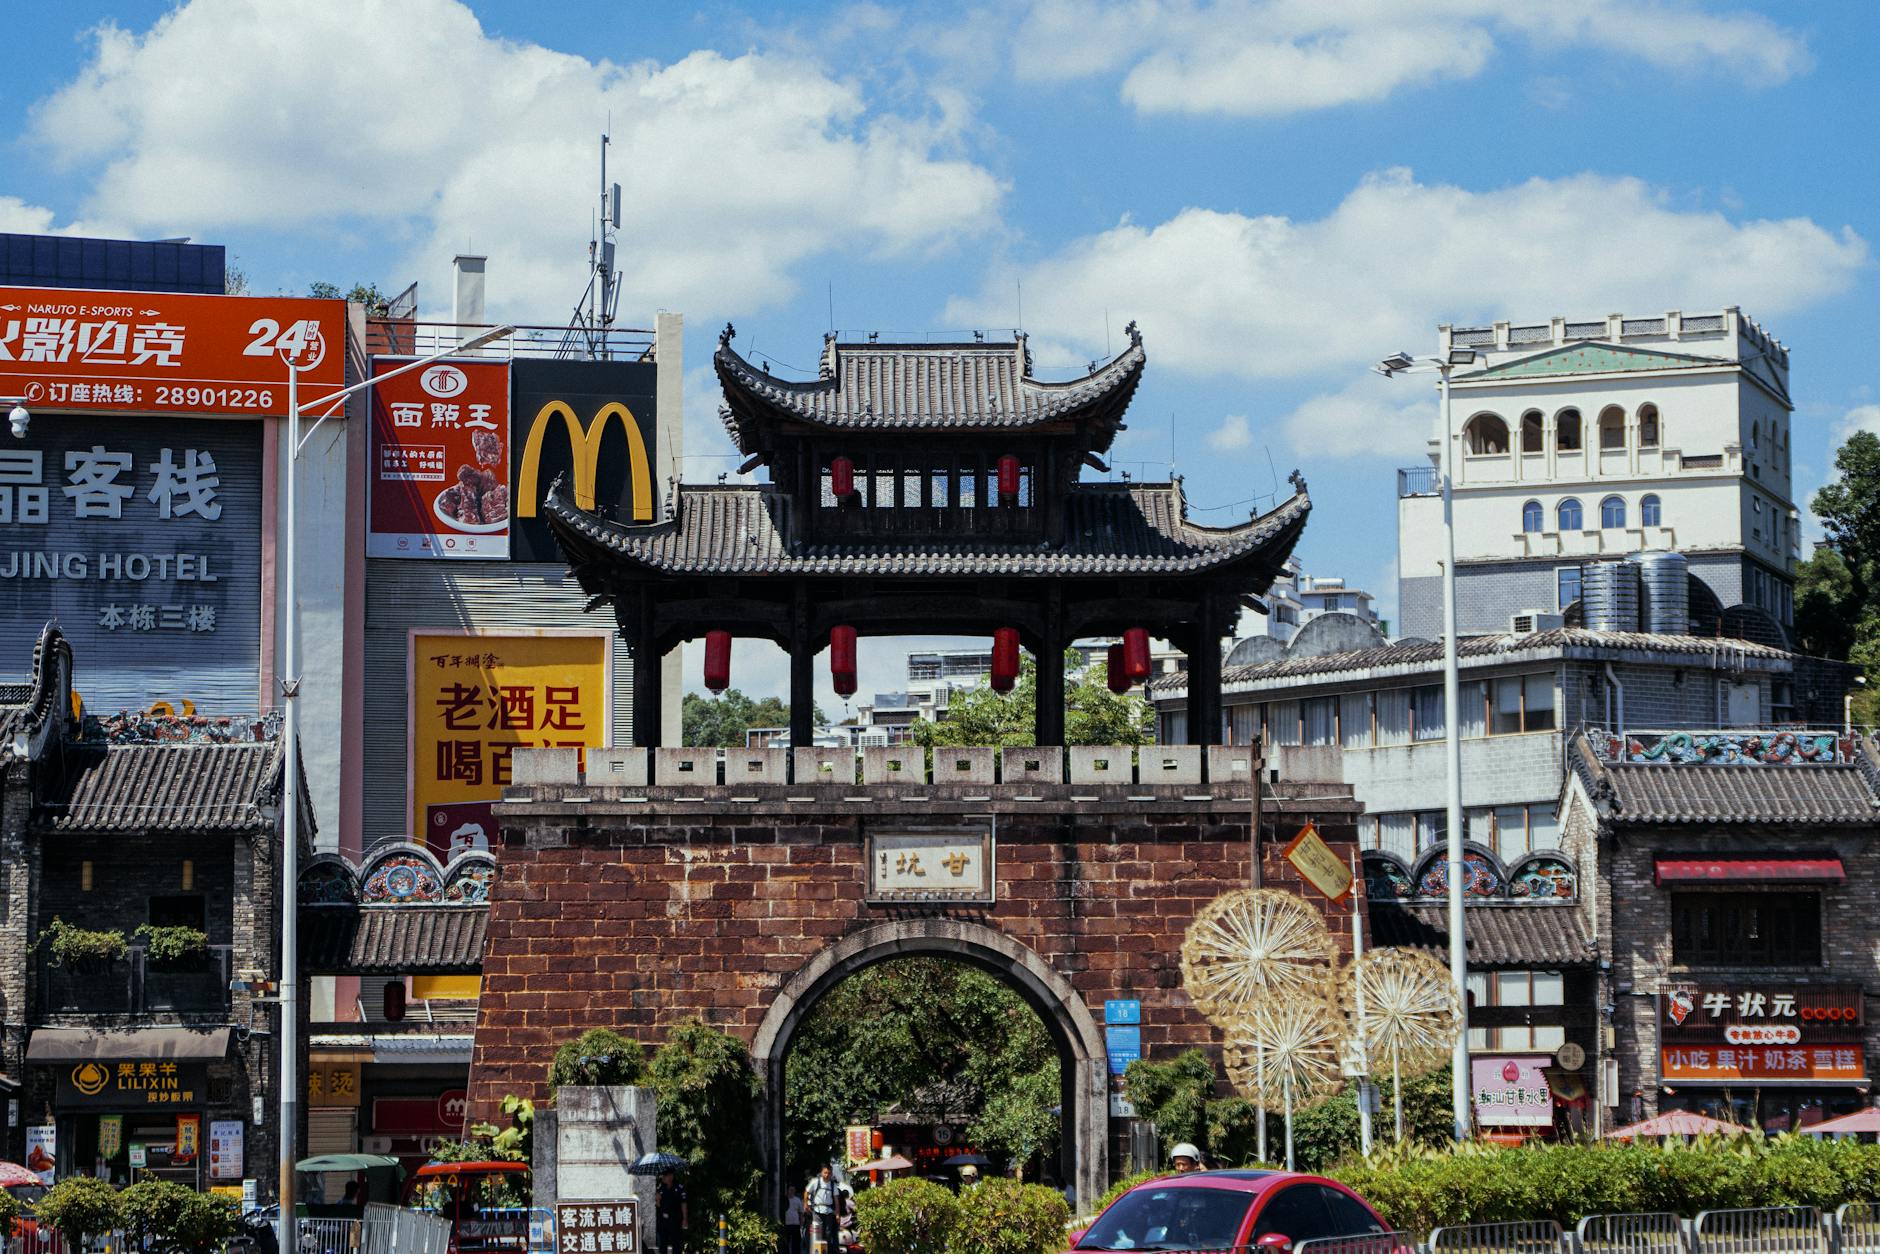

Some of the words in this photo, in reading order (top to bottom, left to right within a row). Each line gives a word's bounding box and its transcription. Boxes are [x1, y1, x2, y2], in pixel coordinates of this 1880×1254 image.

[27, 304, 77, 315] NARUTO
[79, 305, 134, 317] E-SPORTS
[242, 318, 308, 358] 24
[155, 386, 274, 409] 28901226
[99, 553, 218, 582] HOTEL
[99, 603, 216, 632] 本栋三楼
[436, 682, 586, 731] 老酒足
[1702, 992, 1798, 1018] 牛状元
[1668, 1050, 1711, 1070] 小吃
[1716, 1050, 1759, 1070] 果汁
[1764, 1050, 1808, 1071] 奶茶
[1813, 1050, 1857, 1071] 雪糕
[117, 1077, 179, 1090] LILIXIN
[561, 1206, 633, 1229] 客流高峰
[562, 1230, 634, 1253] 交通管制
